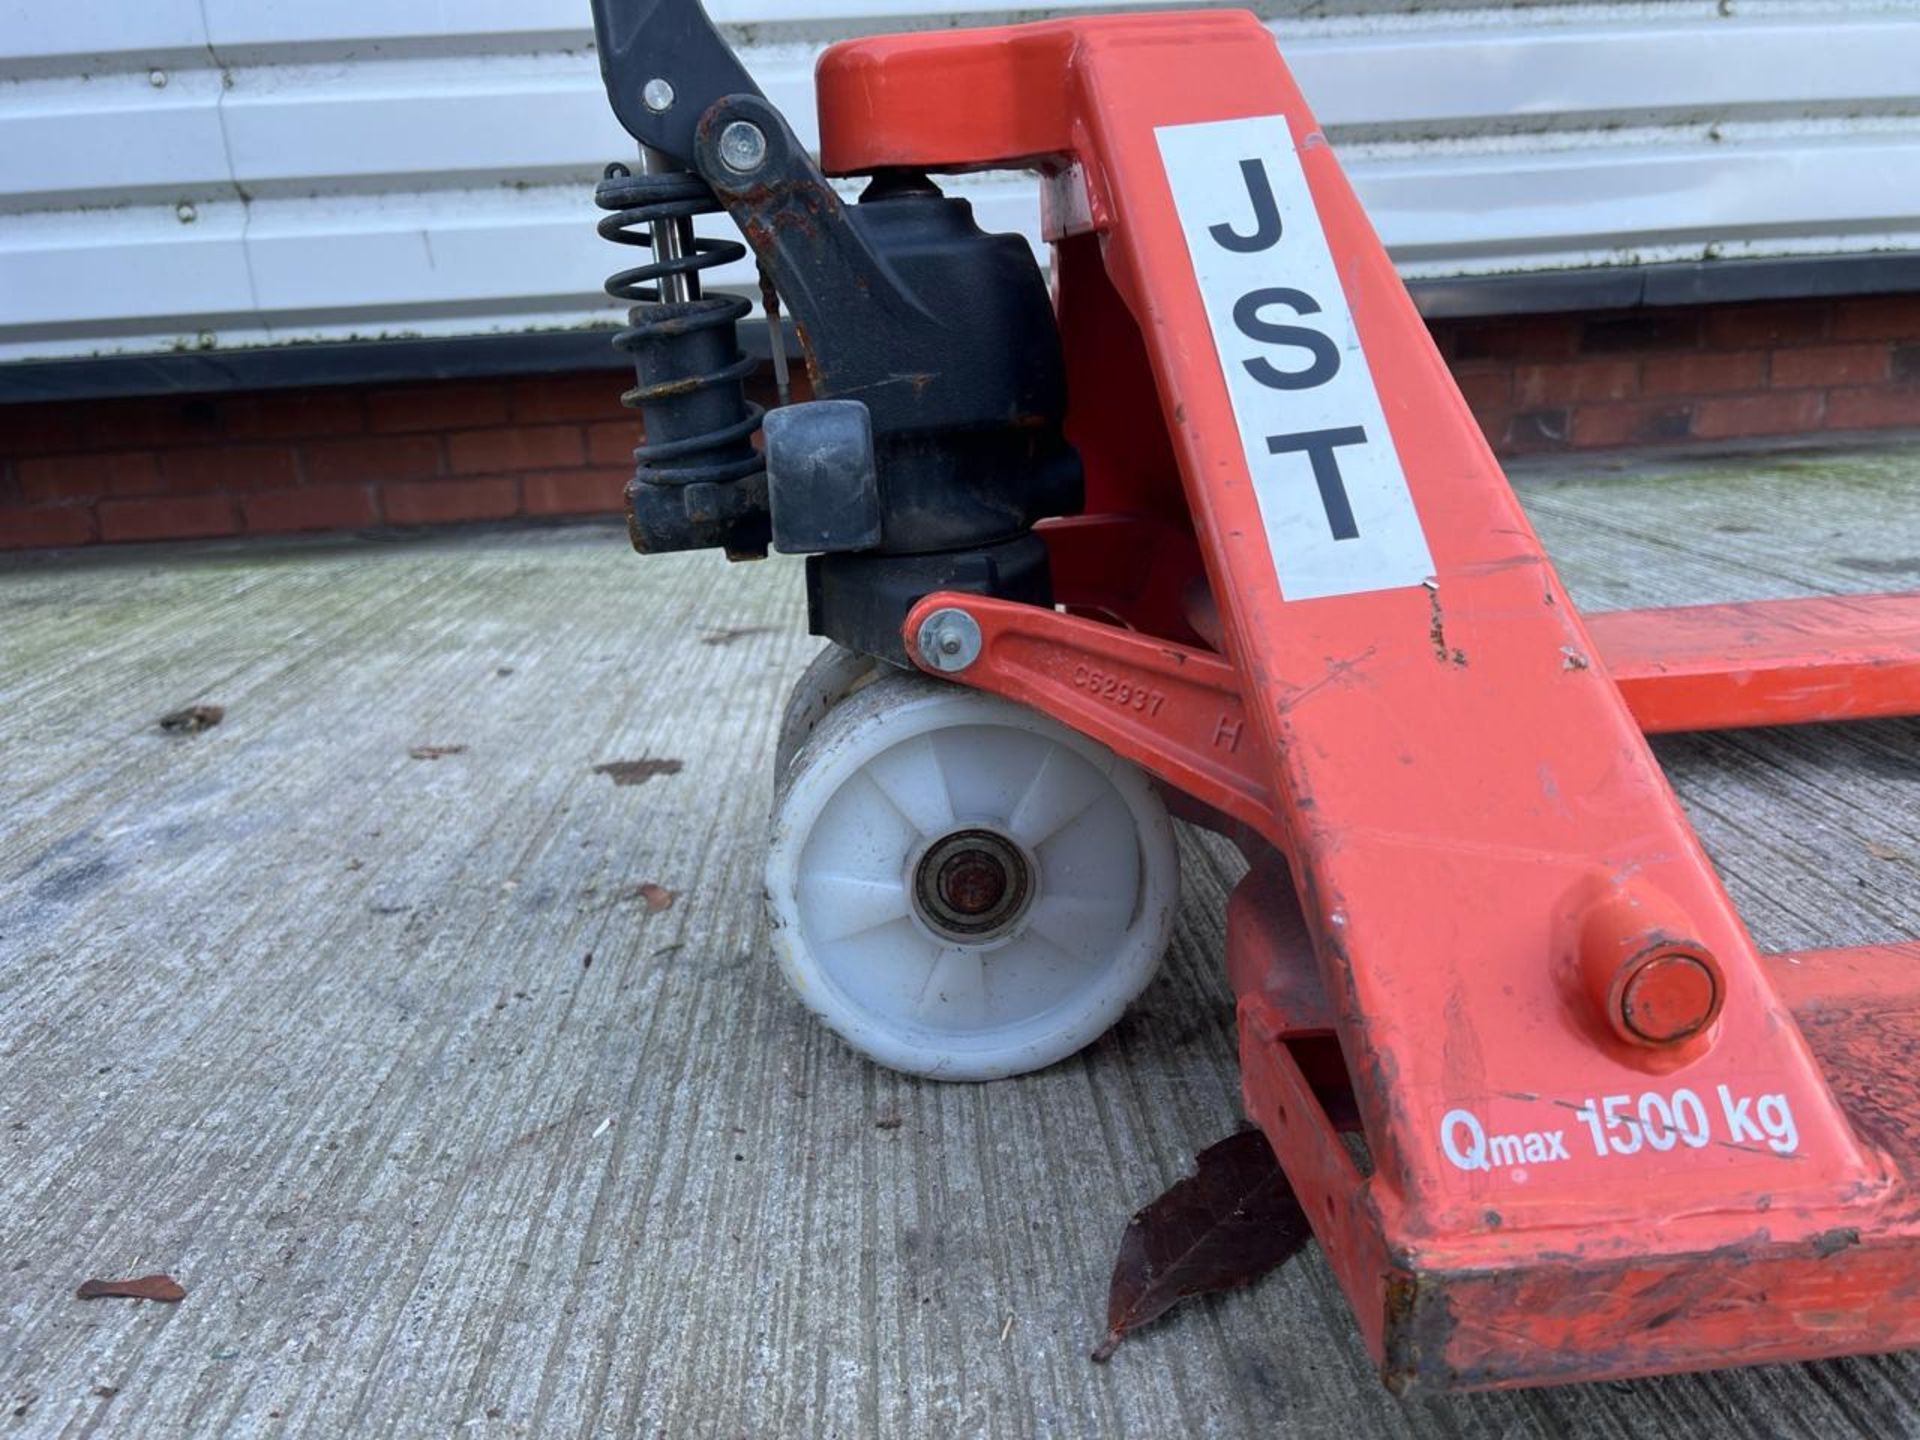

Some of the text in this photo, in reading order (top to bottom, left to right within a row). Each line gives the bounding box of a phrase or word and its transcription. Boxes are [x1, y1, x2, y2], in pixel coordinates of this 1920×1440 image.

[1208, 158, 1368, 541] JST
[1213, 714, 1244, 753] H
[1440, 1083, 1800, 1172] Qmax 1500 kg
